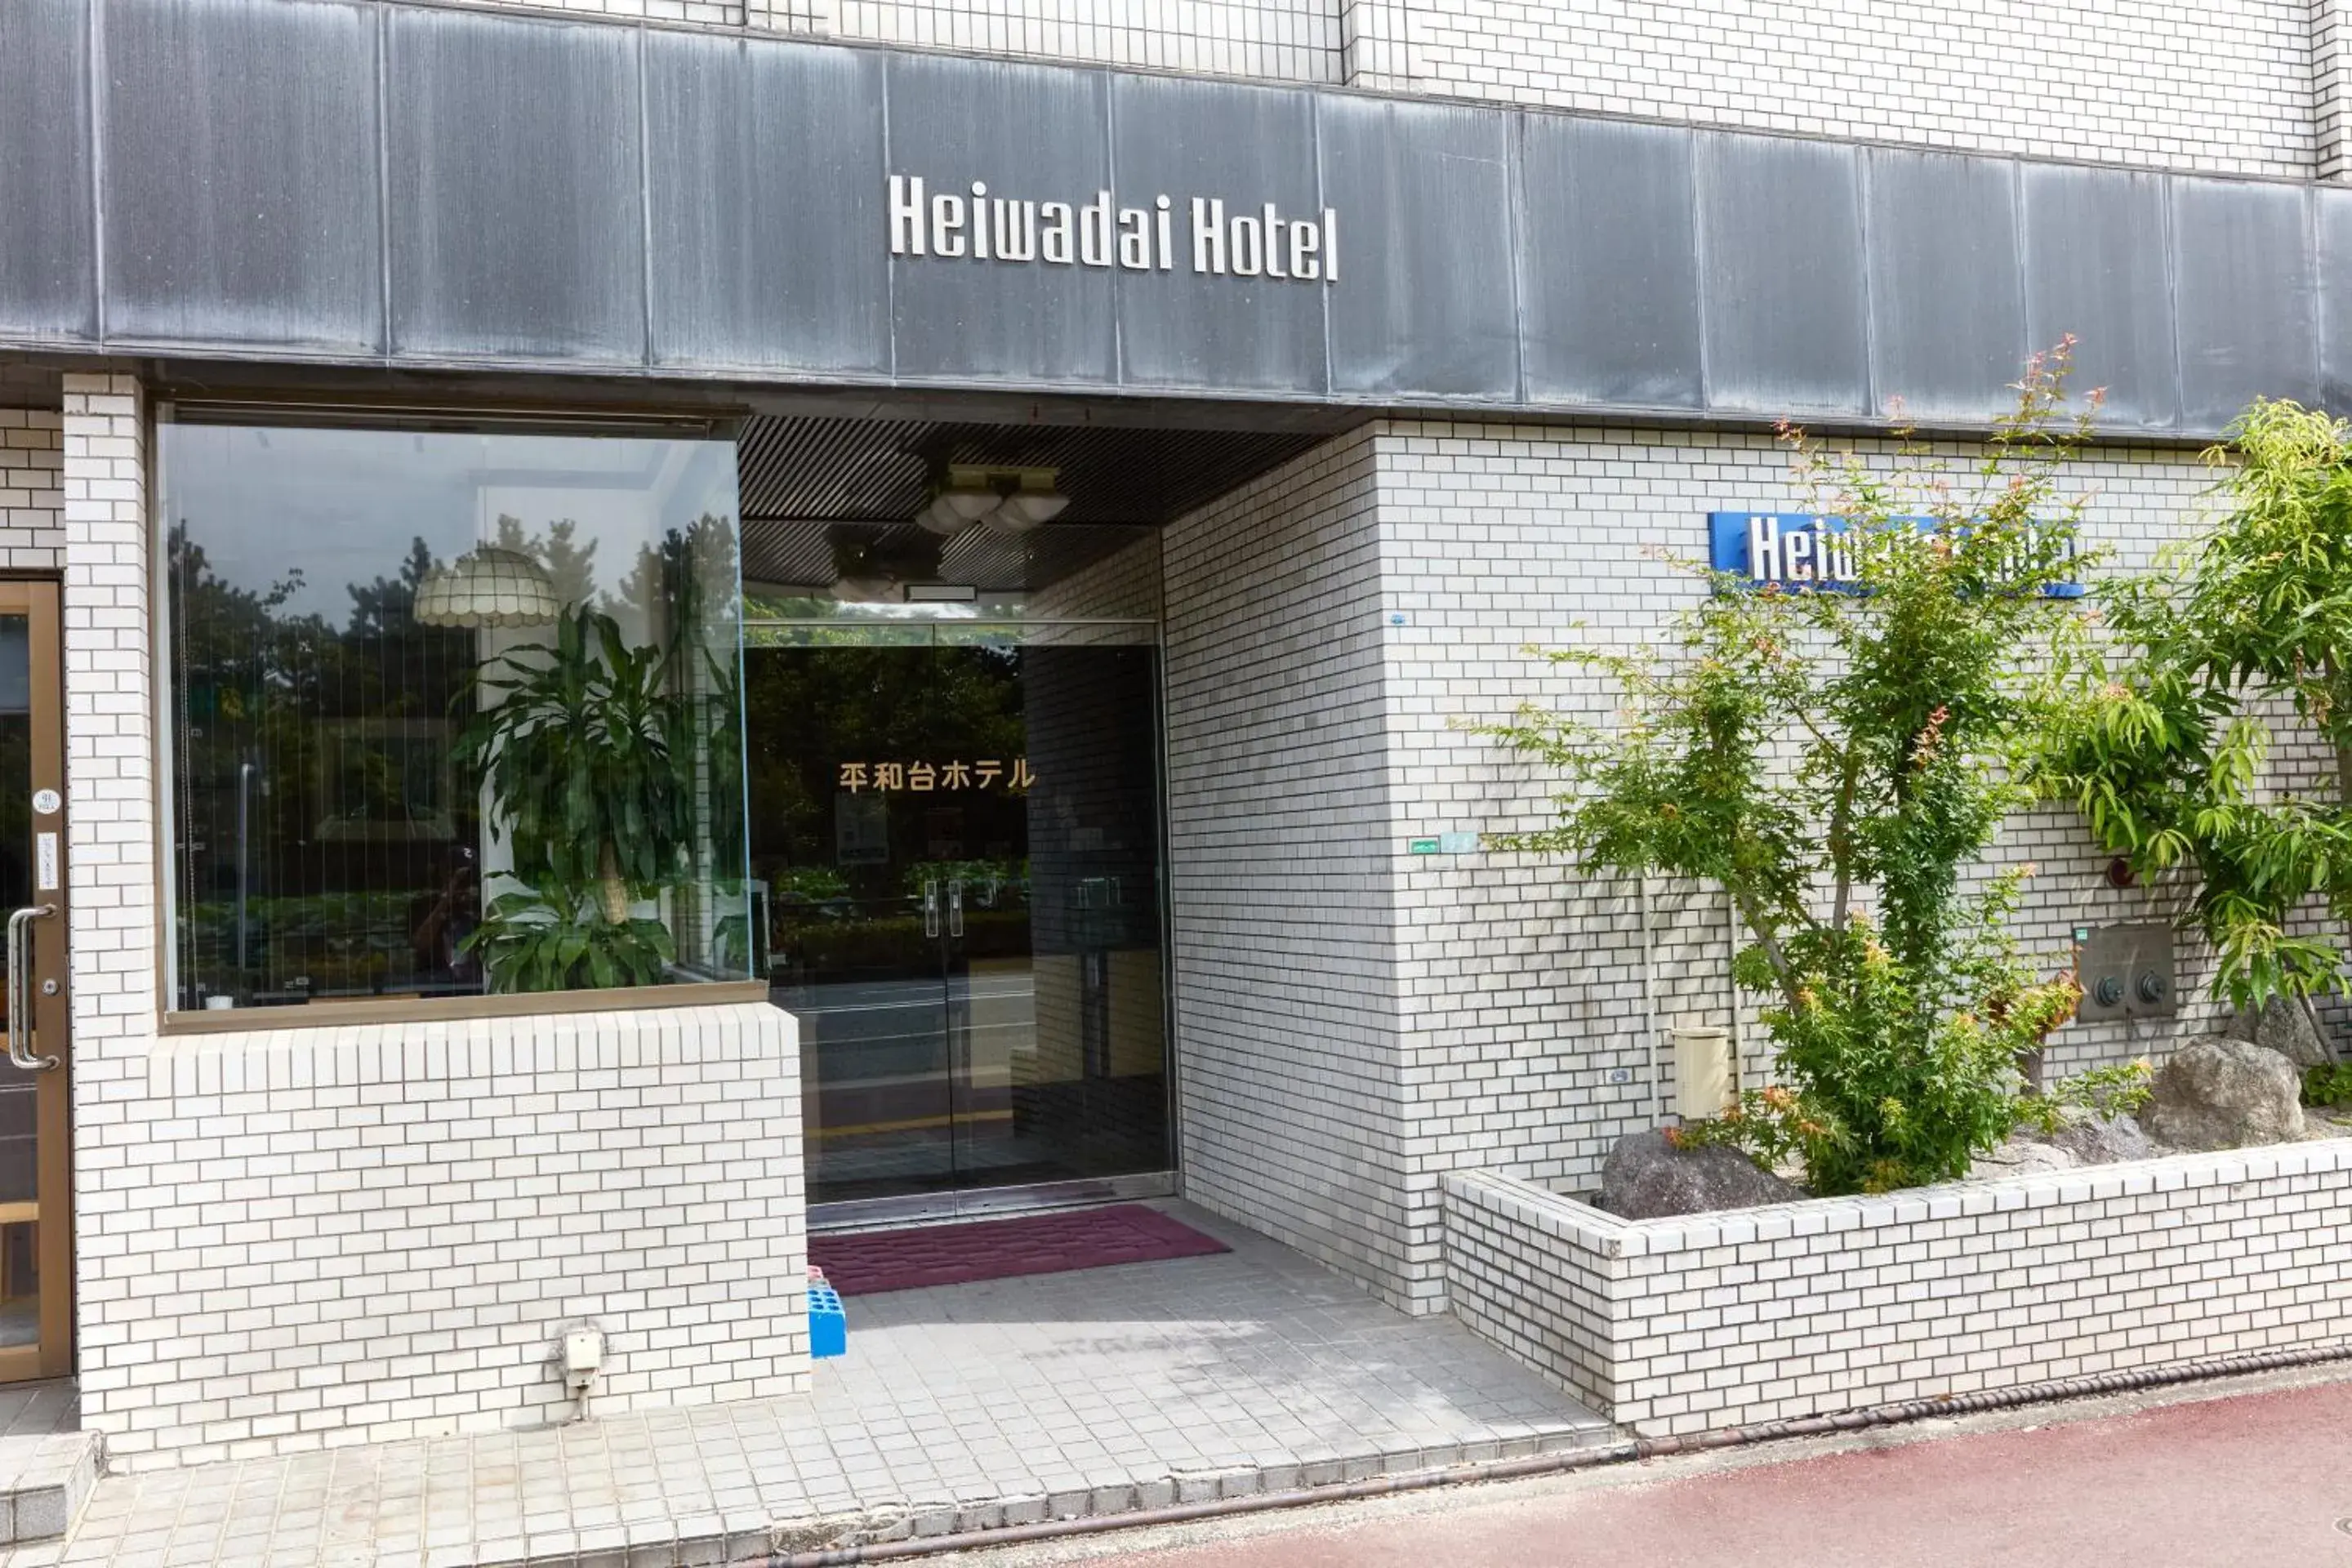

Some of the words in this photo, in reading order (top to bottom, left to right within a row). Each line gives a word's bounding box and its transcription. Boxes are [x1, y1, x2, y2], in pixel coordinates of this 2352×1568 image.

[889, 175, 1173, 270] Heiwadai
[1192, 196, 1339, 282] Hotel
[839, 758, 1036, 794] 平和台ホテル
